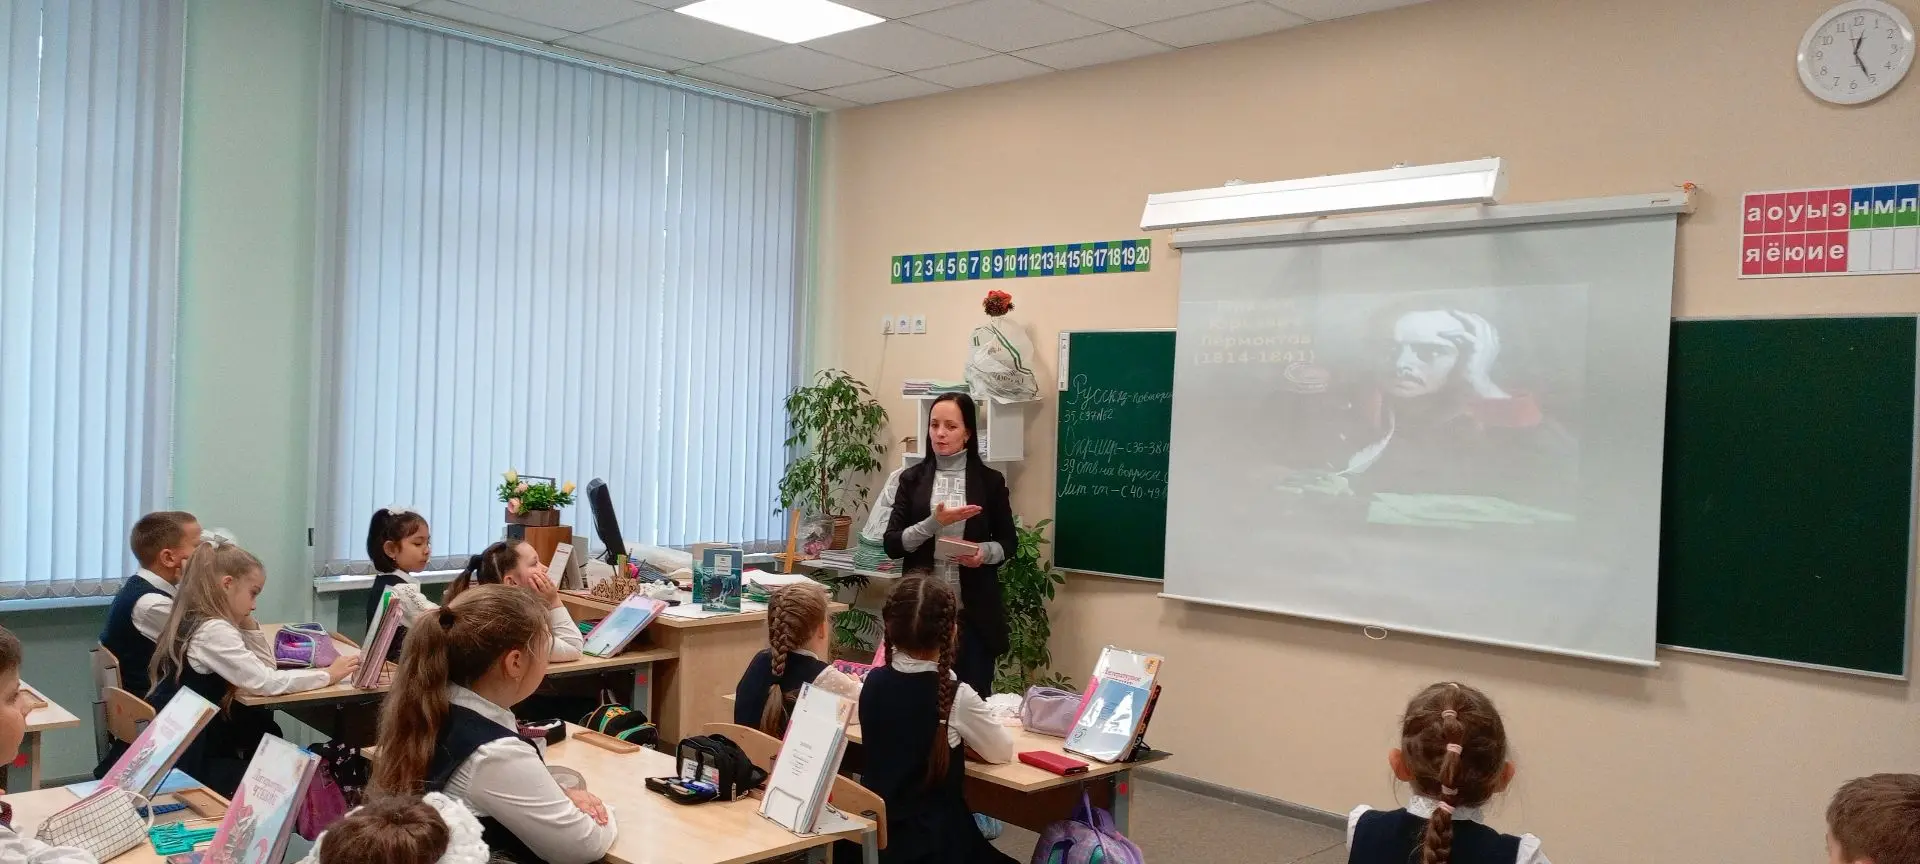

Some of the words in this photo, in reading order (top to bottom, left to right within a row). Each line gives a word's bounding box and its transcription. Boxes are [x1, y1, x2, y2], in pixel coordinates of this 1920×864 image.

[1854, 16, 1864, 26] 12
[1875, 18, 1879, 28] 1
[1837, 23, 1846, 32] 11
[1887, 29, 1893, 39] 2
[1821, 35, 1833, 45] 10
[1891, 44, 1897, 55] 3
[1816, 51, 1823, 60] 9
[1884, 61, 1892, 70] 4
[1820, 66, 1828, 76] 8
[1833, 76, 1840, 86] 7
[1869, 73, 1876, 83] 5
[1849, 80, 1857, 90] 6
[1747, 207, 1761, 221] а
[1767, 205, 1783, 221] о
[1788, 204, 1803, 223] у
[1807, 203, 1827, 218] ы
[1832, 202, 1847, 216] э
[1853, 201, 1868, 215] н
[1875, 199, 1893, 214] м
[1898, 197, 1917, 213] л
[1745, 248, 1760, 262] я
[1766, 242, 1780, 261] ё
[1785, 246, 1804, 261] ю
[1808, 245, 1823, 260] и
[1829, 243, 1844, 259] е
[893, 262, 900, 277] 0
[904, 261, 909, 277] 1
[915, 261, 922, 276] 2
[925, 260, 933, 275] 3
[936, 259, 944, 274] 4
[947, 258, 955, 274] 5
[959, 258, 967, 273] 6
[970, 257, 979, 273] 7
[982, 256, 990, 272] 8
[994, 256, 1003, 272] 9
[1004, 255, 1016, 271] 10
[1018, 254, 1027, 270] 11
[1029, 253, 1041, 270] 12
[1042, 252, 1053, 269] 13
[1055, 252, 1066, 268] 14
[1067, 250, 1080, 267] 15
[1080, 250, 1093, 267] 16
[1094, 249, 1107, 266] 17
[1108, 248, 1120, 266] 18
[1122, 247, 1135, 265] 19
[1136, 246, 1150, 264] 20
[1194, 349, 1315, 366] (1814-1841)
